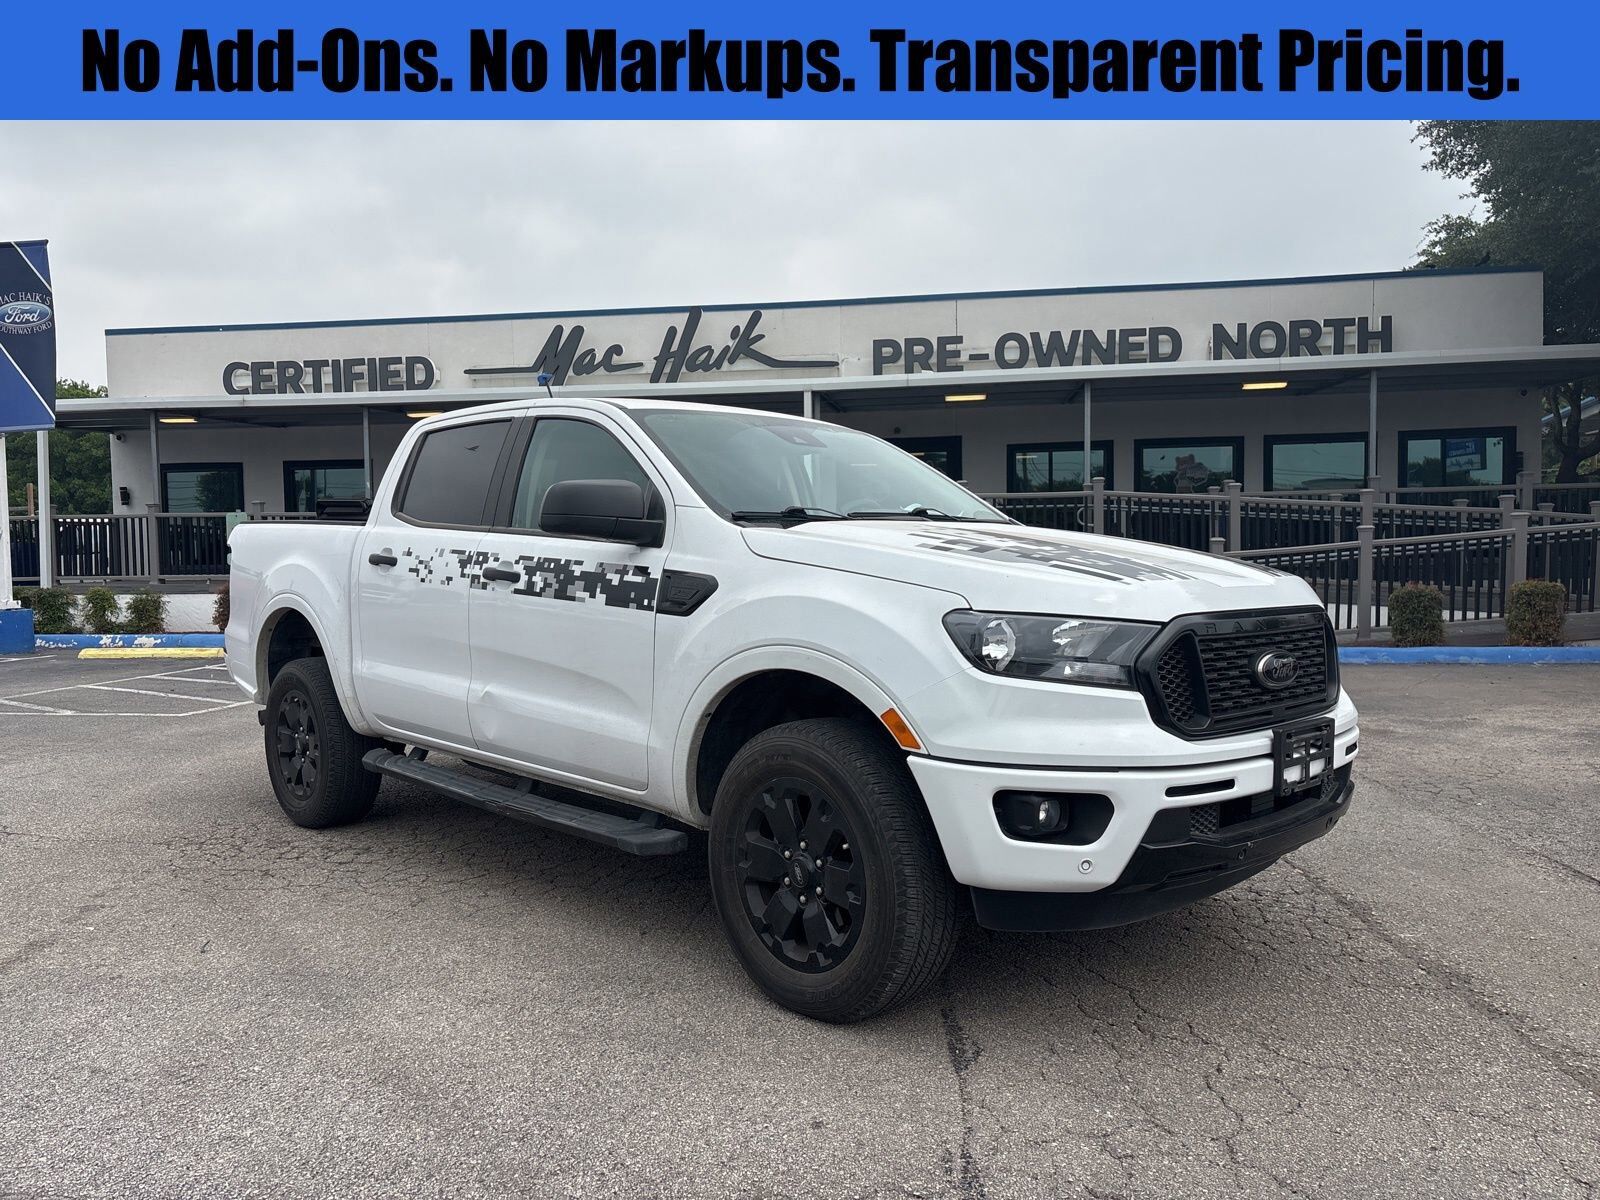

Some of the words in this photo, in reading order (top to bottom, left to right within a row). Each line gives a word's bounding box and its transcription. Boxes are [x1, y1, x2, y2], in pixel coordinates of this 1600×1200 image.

[19, 292, 52, 305] HAIK'S
[5, 305, 40, 322] Ford
[33, 321, 52, 333] FORD
[520, 324, 644, 387] Mac
[650, 306, 785, 384] Haik
[872, 326, 1183, 375] PRE-OWNED
[1212, 315, 1393, 360] NORTH
[222, 355, 435, 395] CERTIFIED
[1272, 657, 1296, 679] Ford
